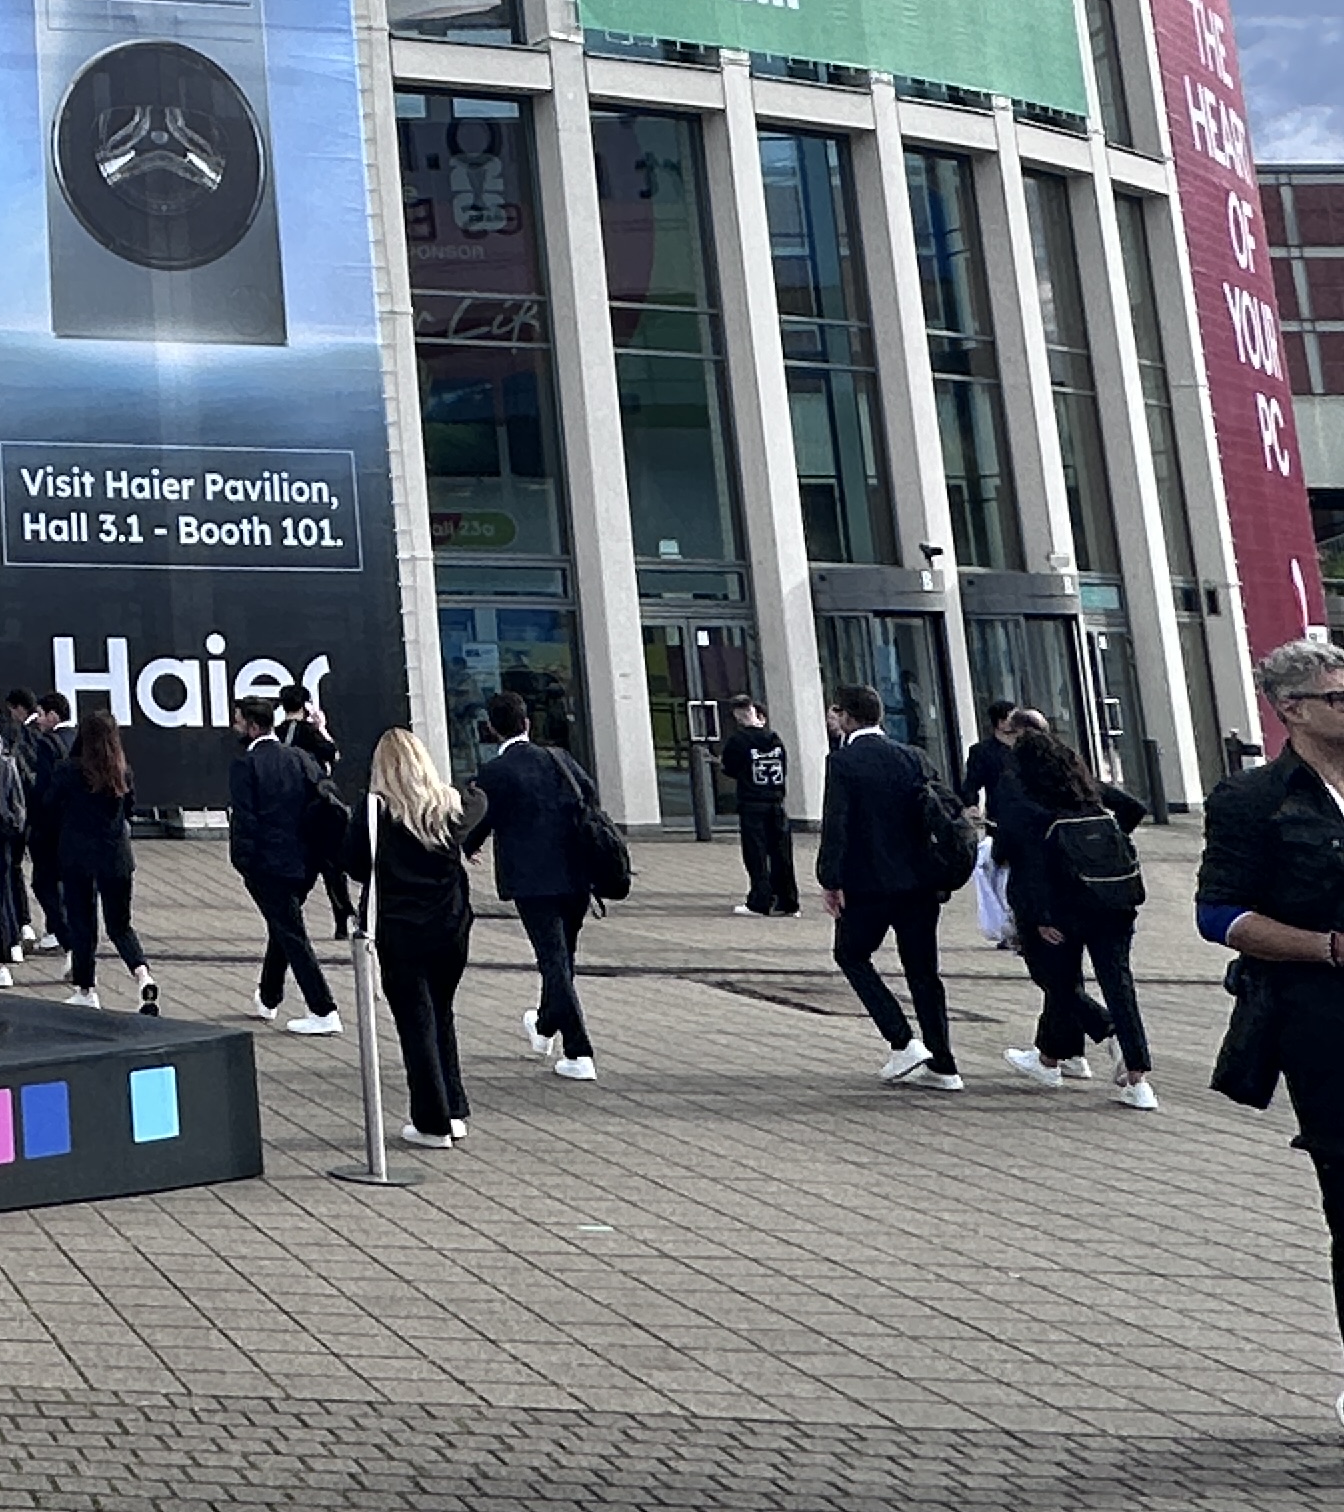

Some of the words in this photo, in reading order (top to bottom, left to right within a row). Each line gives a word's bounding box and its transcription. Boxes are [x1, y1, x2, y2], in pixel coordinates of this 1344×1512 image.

[1226, 189, 1257, 274] OF
[1223, 281, 1284, 383] YOUR
[1255, 391, 1291, 478] PC
[21, 466, 95, 498] Visit
[105, 470, 195, 500] Haier
[205, 472, 340, 510] Pavilion,
[23, 513, 88, 541] Hall
[99, 514, 143, 543] 3.1
[178, 517, 272, 545] Booth
[282, 518, 343, 547] 101.
